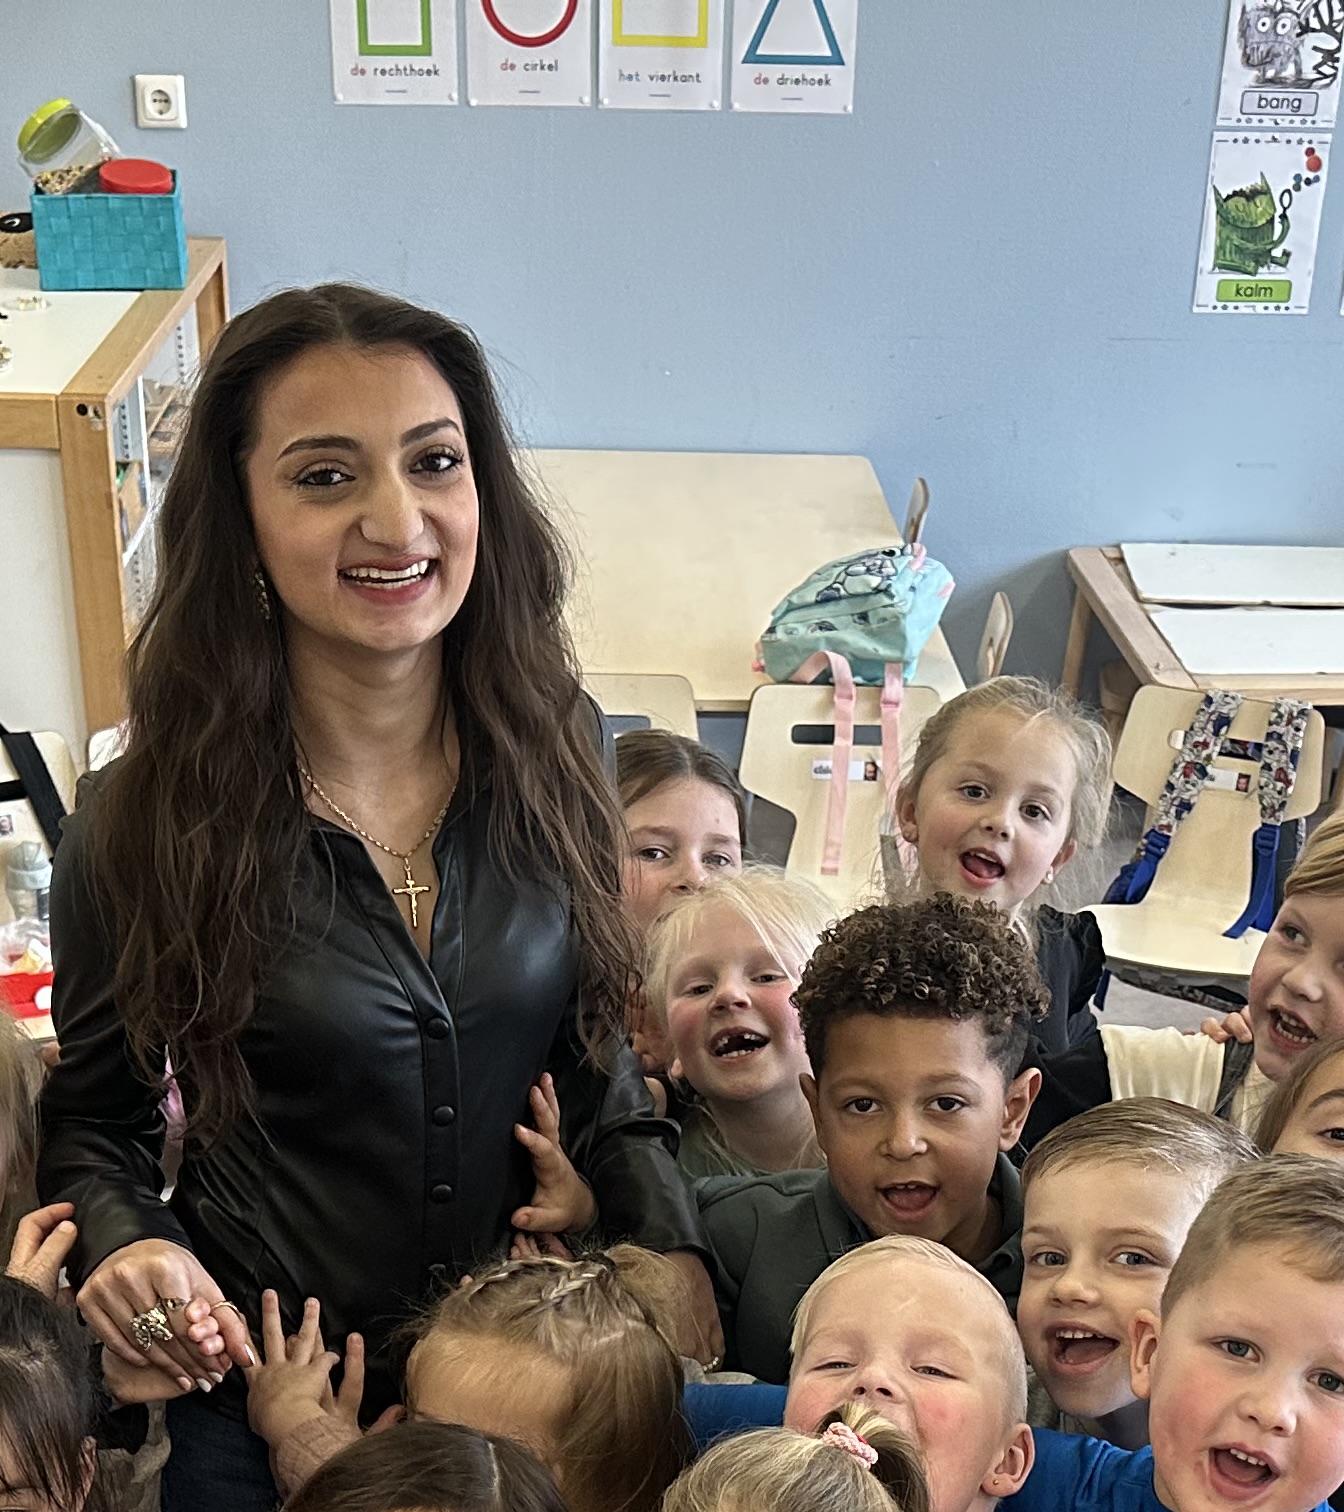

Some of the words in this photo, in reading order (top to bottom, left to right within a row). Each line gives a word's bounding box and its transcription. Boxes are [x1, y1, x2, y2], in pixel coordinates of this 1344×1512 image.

[350, 63, 367, 78] de
[372, 63, 441, 79] rechthoek
[499, 58, 517, 73] de
[522, 58, 559, 73] cirkel
[617, 69, 642, 83] het
[647, 69, 702, 84] vierkant
[752, 72, 770, 87] de
[775, 73, 832, 88] driehoek
[1256, 93, 1303, 115] bang
[1233, 282, 1275, 299] kalm
